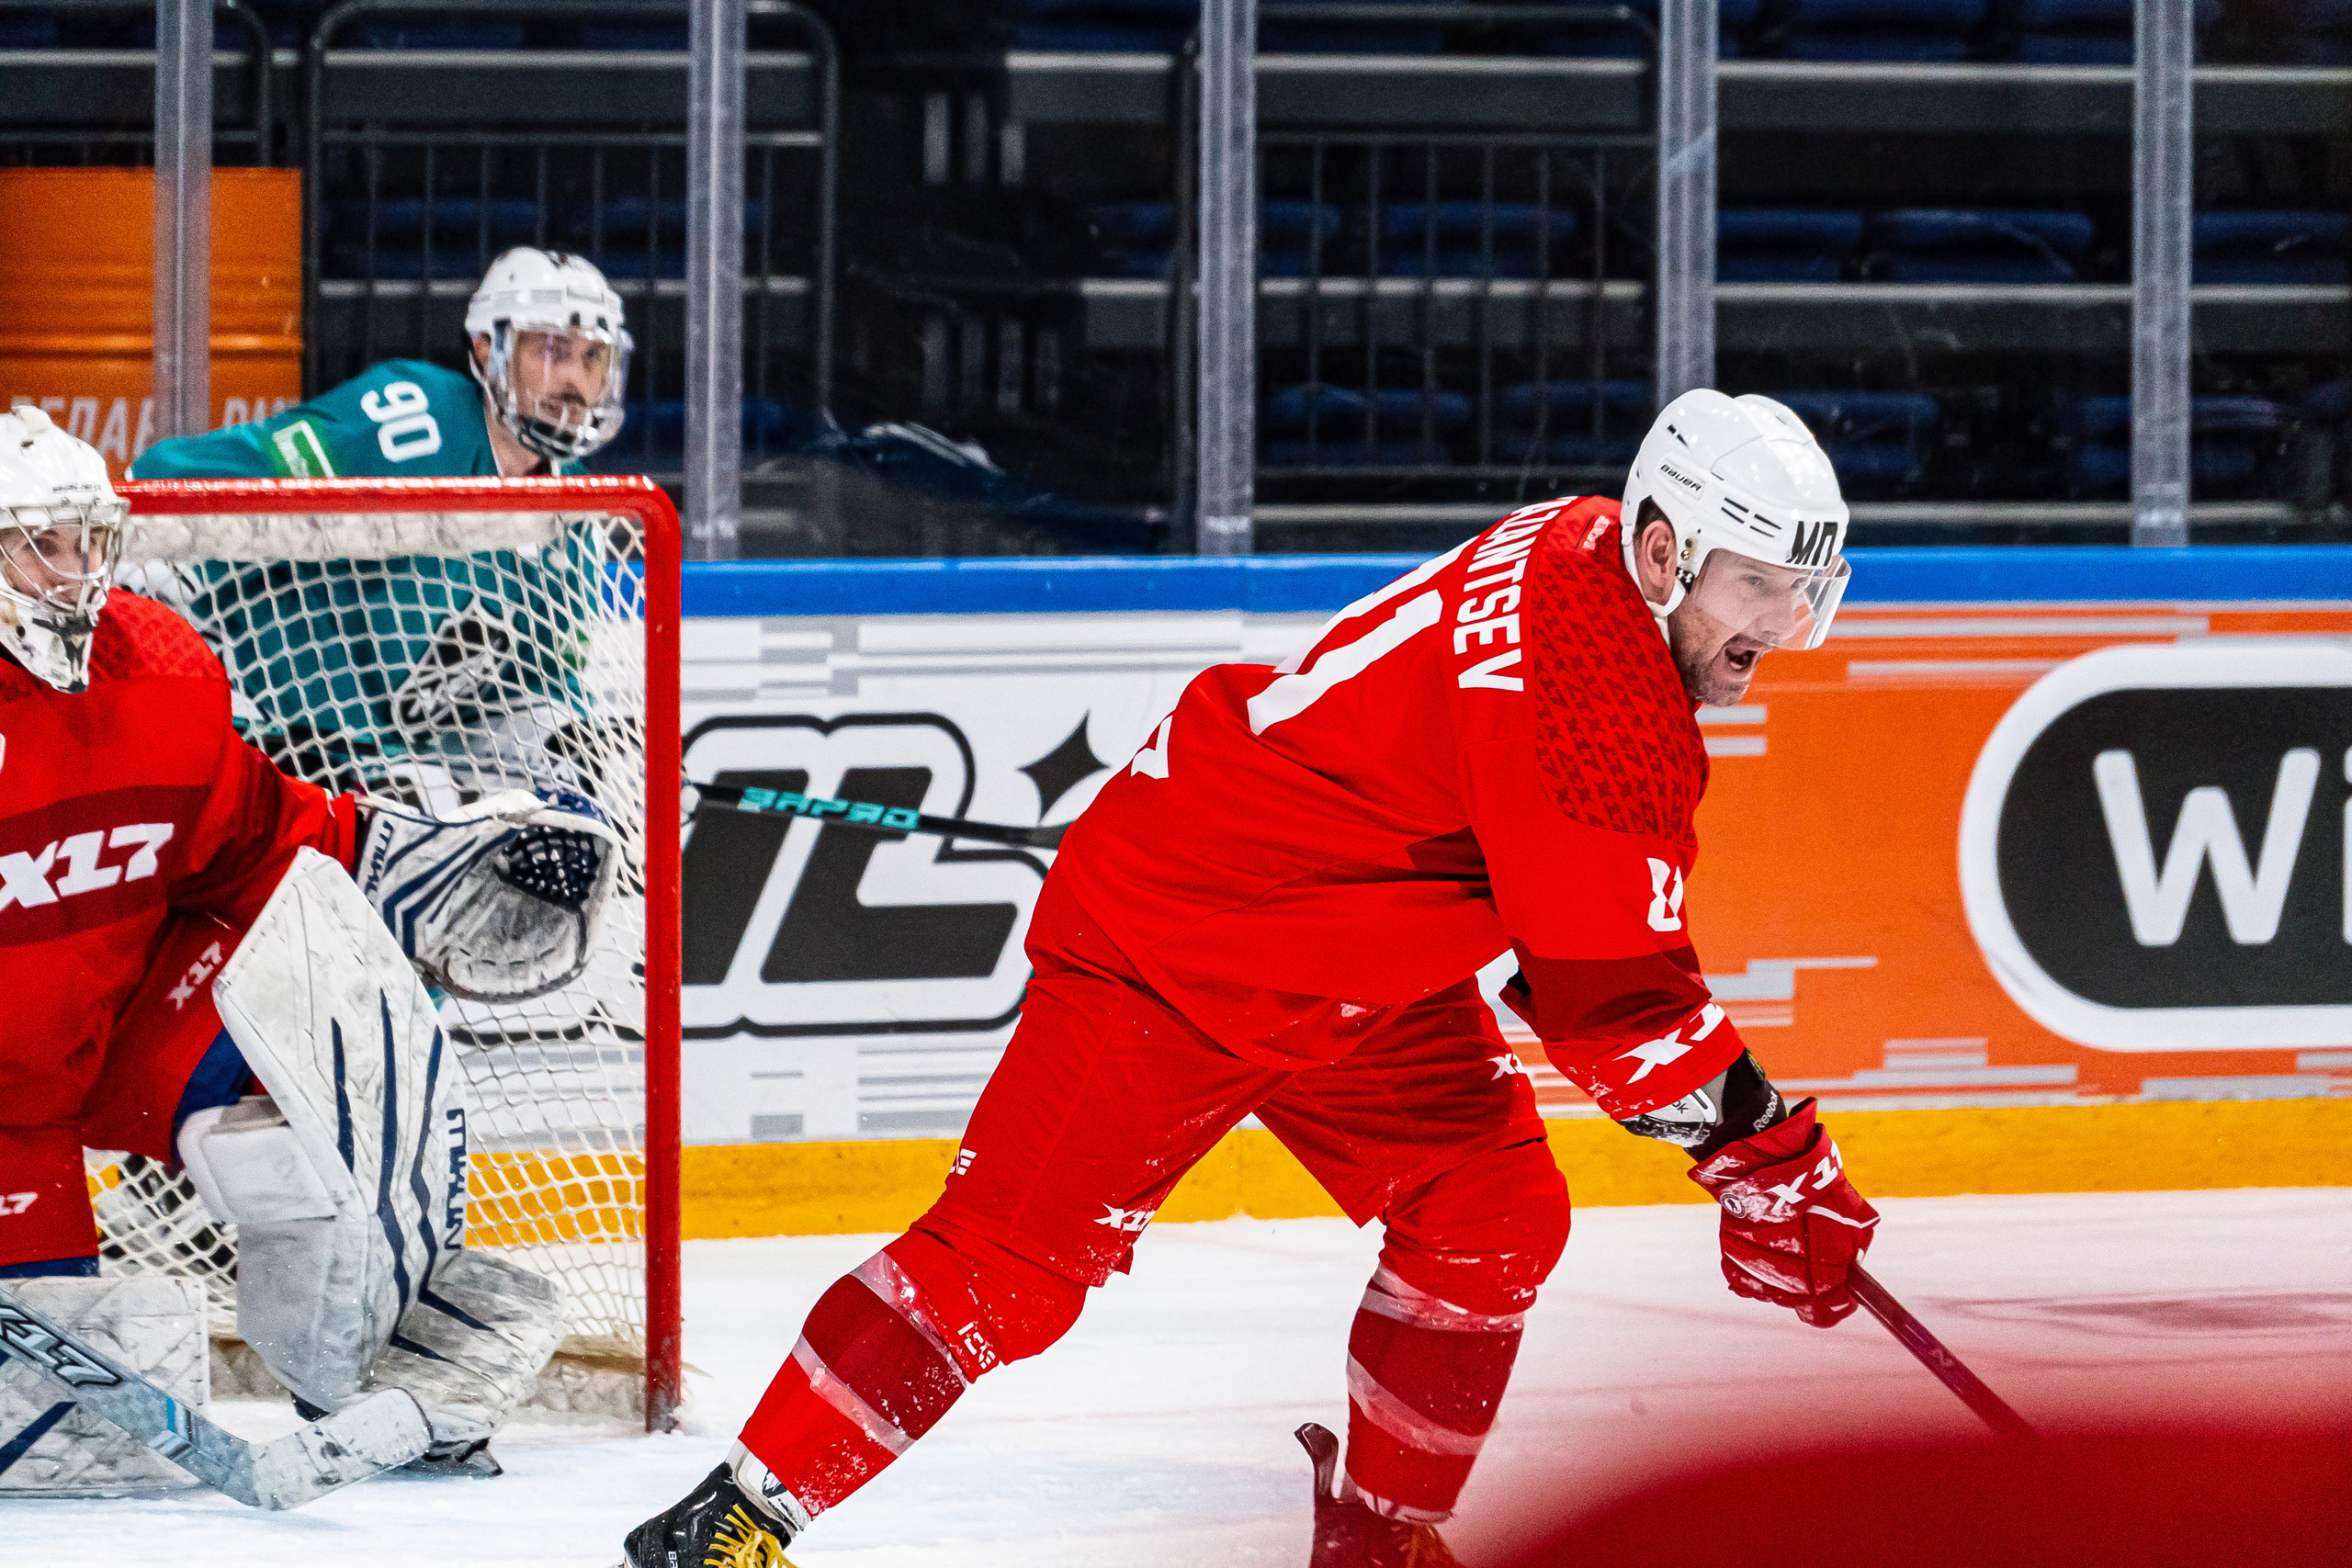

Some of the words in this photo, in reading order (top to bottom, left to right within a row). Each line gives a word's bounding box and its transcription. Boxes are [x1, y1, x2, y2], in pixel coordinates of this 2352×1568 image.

[360, 381, 442, 462] 90
[1453, 496, 1578, 692] AZANTSEV
[166, 941, 223, 1010] X17
